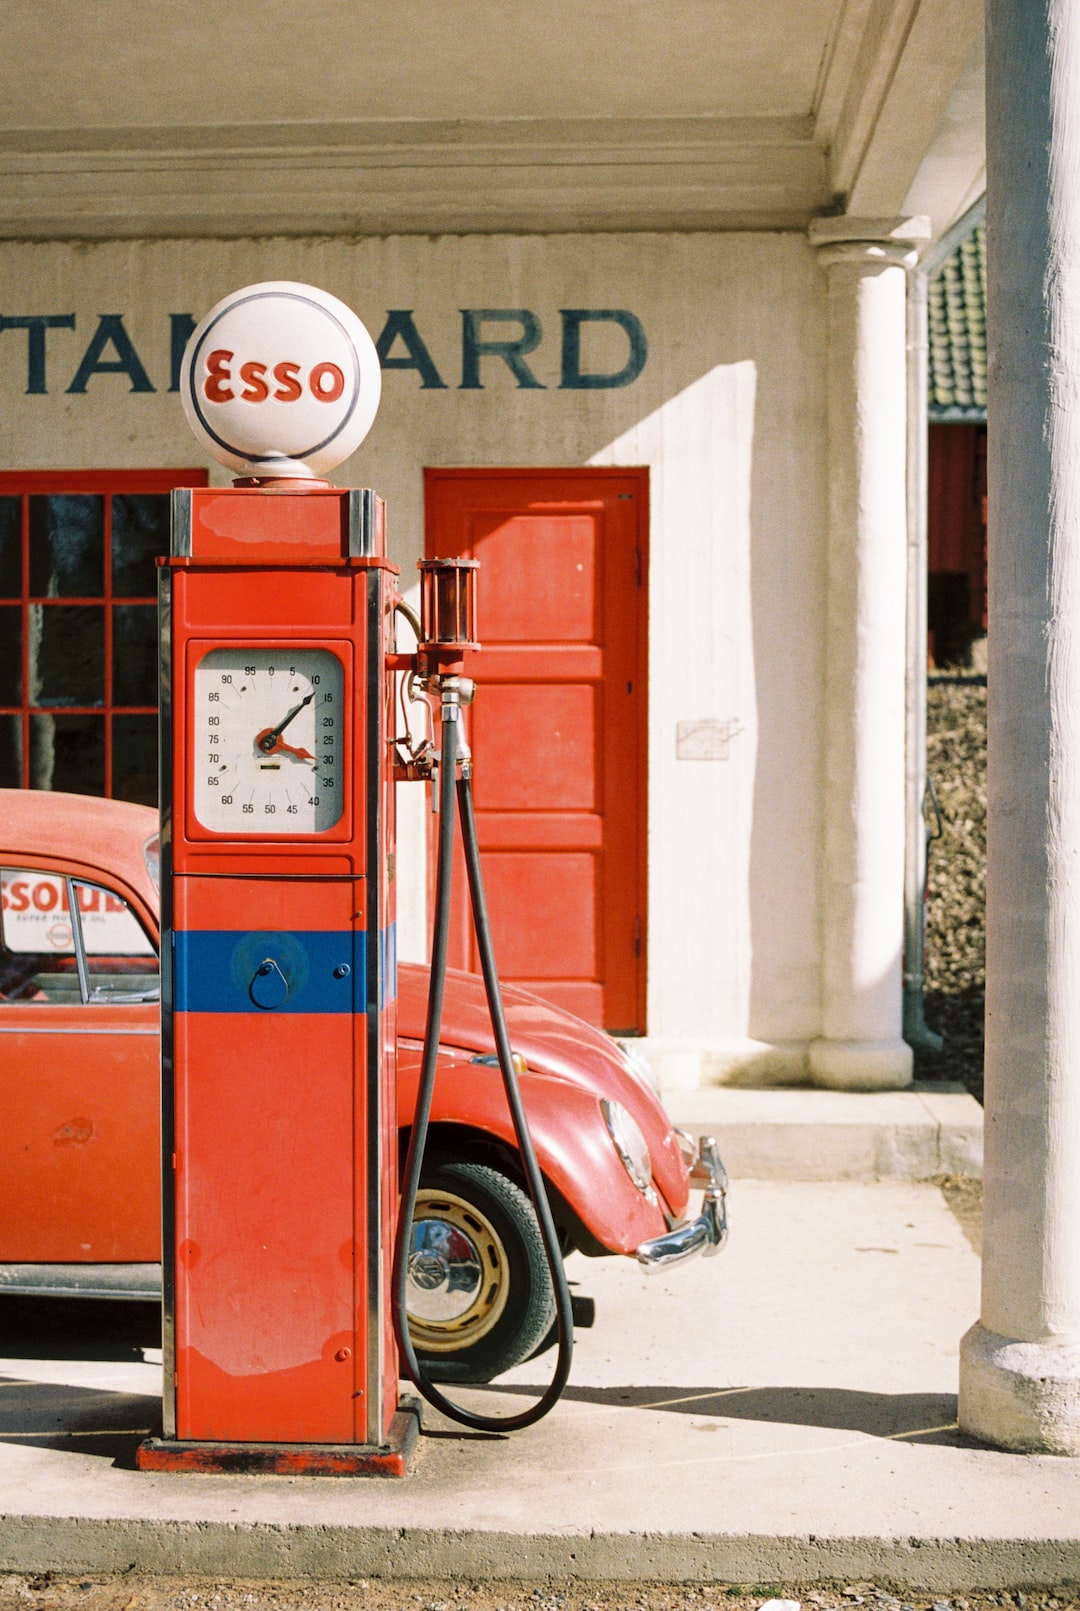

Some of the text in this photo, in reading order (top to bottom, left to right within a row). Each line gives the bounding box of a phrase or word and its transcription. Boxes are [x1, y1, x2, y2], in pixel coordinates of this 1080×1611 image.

[245, 667, 256, 676] 95
[268, 667, 275, 676] 0
[289, 667, 296, 676] 5
[221, 675, 232, 685] 90
[312, 675, 321, 685] 10
[208, 693, 220, 702] 85
[324, 693, 333, 702] 15
[208, 717, 220, 726] 80
[323, 718, 334, 727] 20
[208, 735, 219, 744] 75
[323, 736, 334, 745] 25
[208, 754, 220, 763] 70
[323, 754, 334, 764] 30
[207, 777, 219, 786] 65
[323, 777, 334, 787] 35
[221, 795, 233, 805] 60
[308, 796, 320, 806] 40
[242, 804, 254, 814] 55
[264, 804, 276, 814] 50
[286, 804, 298, 814] 45
